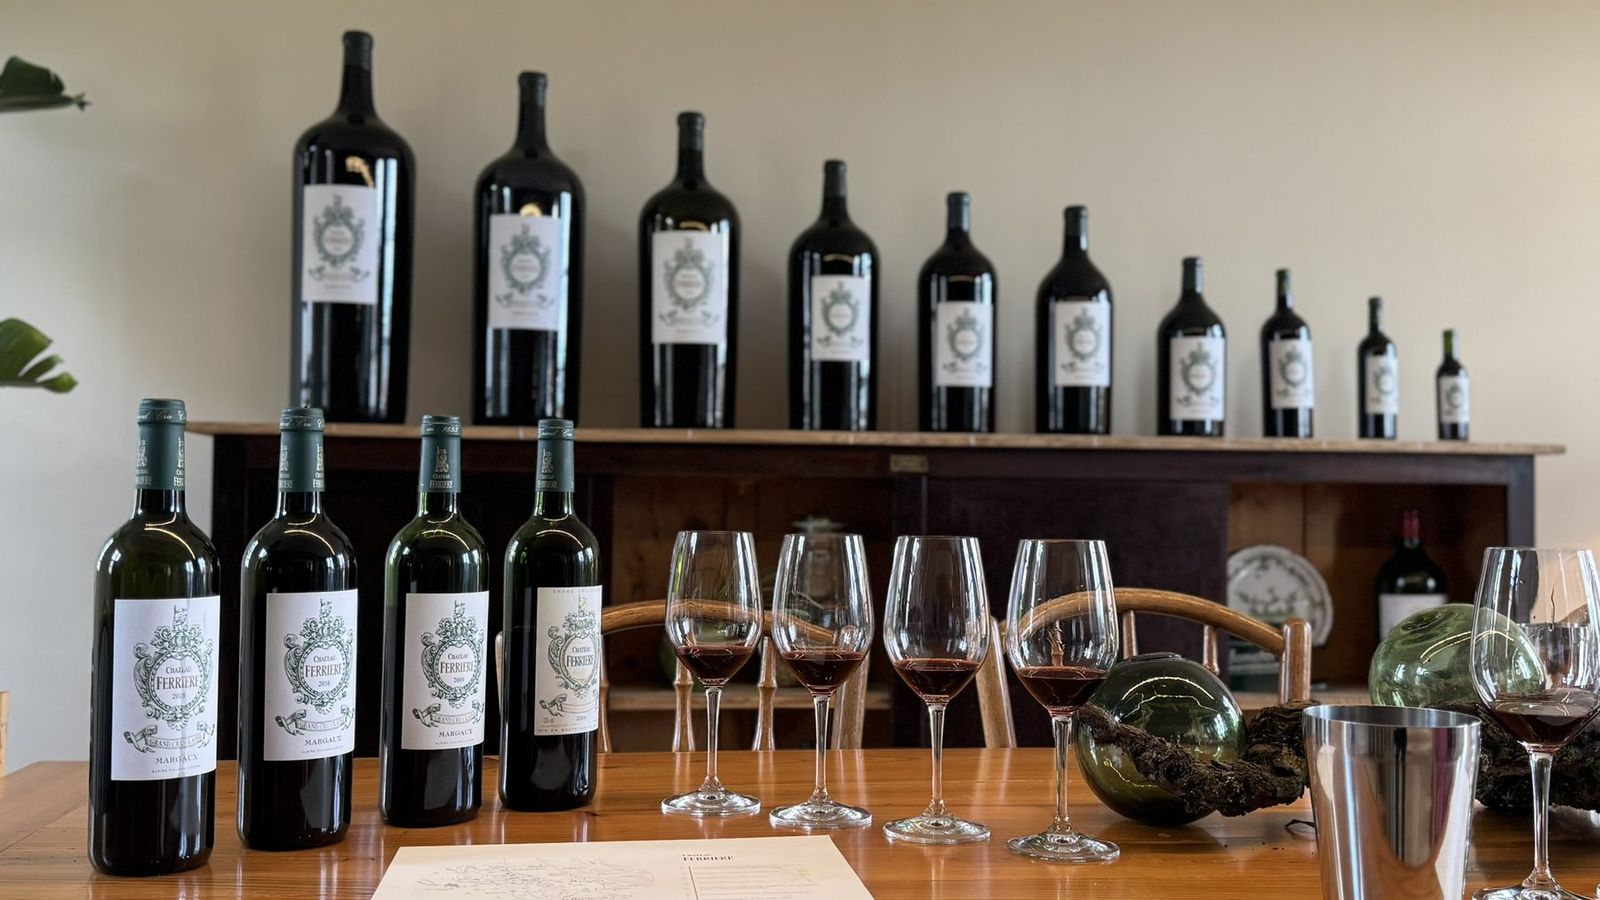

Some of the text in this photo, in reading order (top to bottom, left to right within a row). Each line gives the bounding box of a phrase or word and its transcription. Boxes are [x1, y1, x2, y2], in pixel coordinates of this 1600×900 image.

[438, 729, 473, 738] MARGAUX
[304, 735, 342, 746] MARGAUX
[154, 753, 198, 764] MARGAUX
